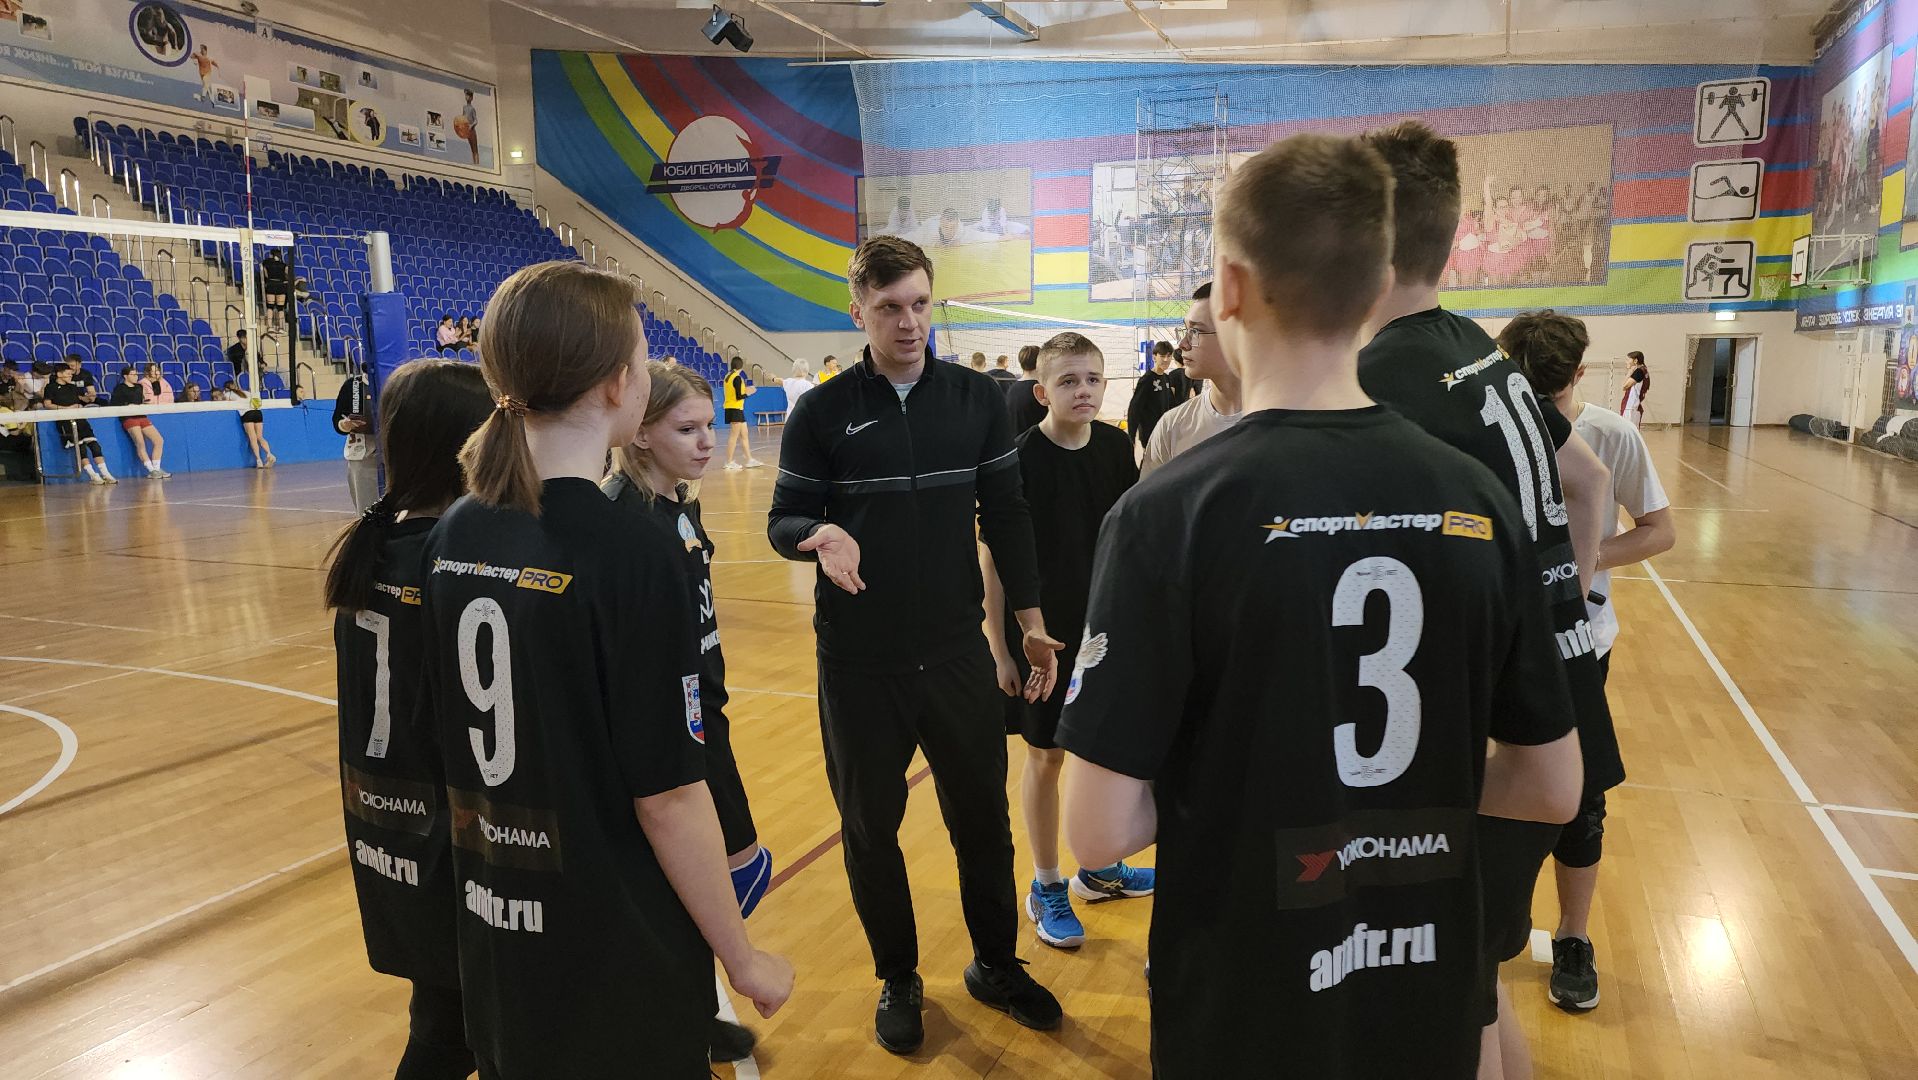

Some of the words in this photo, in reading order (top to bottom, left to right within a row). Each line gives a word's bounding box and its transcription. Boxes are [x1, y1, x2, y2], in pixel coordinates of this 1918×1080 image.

[663, 160, 749, 176] ЮБИЛЕЙНЫЙ
[709, 182, 737, 190] СПОРТА
[1479, 372, 1568, 542] 10
[1449, 514, 1489, 535] PRO
[521, 571, 564, 590] PRO
[356, 609, 391, 758] 7
[1332, 556, 1424, 787] 3
[457, 597, 516, 787] 9
[358, 788, 427, 816] YOKOHAMA
[478, 814, 551, 849] YOKOHAMA
[355, 839, 419, 886] amfr.ru
[1336, 833, 1450, 871] YOKOHAMA
